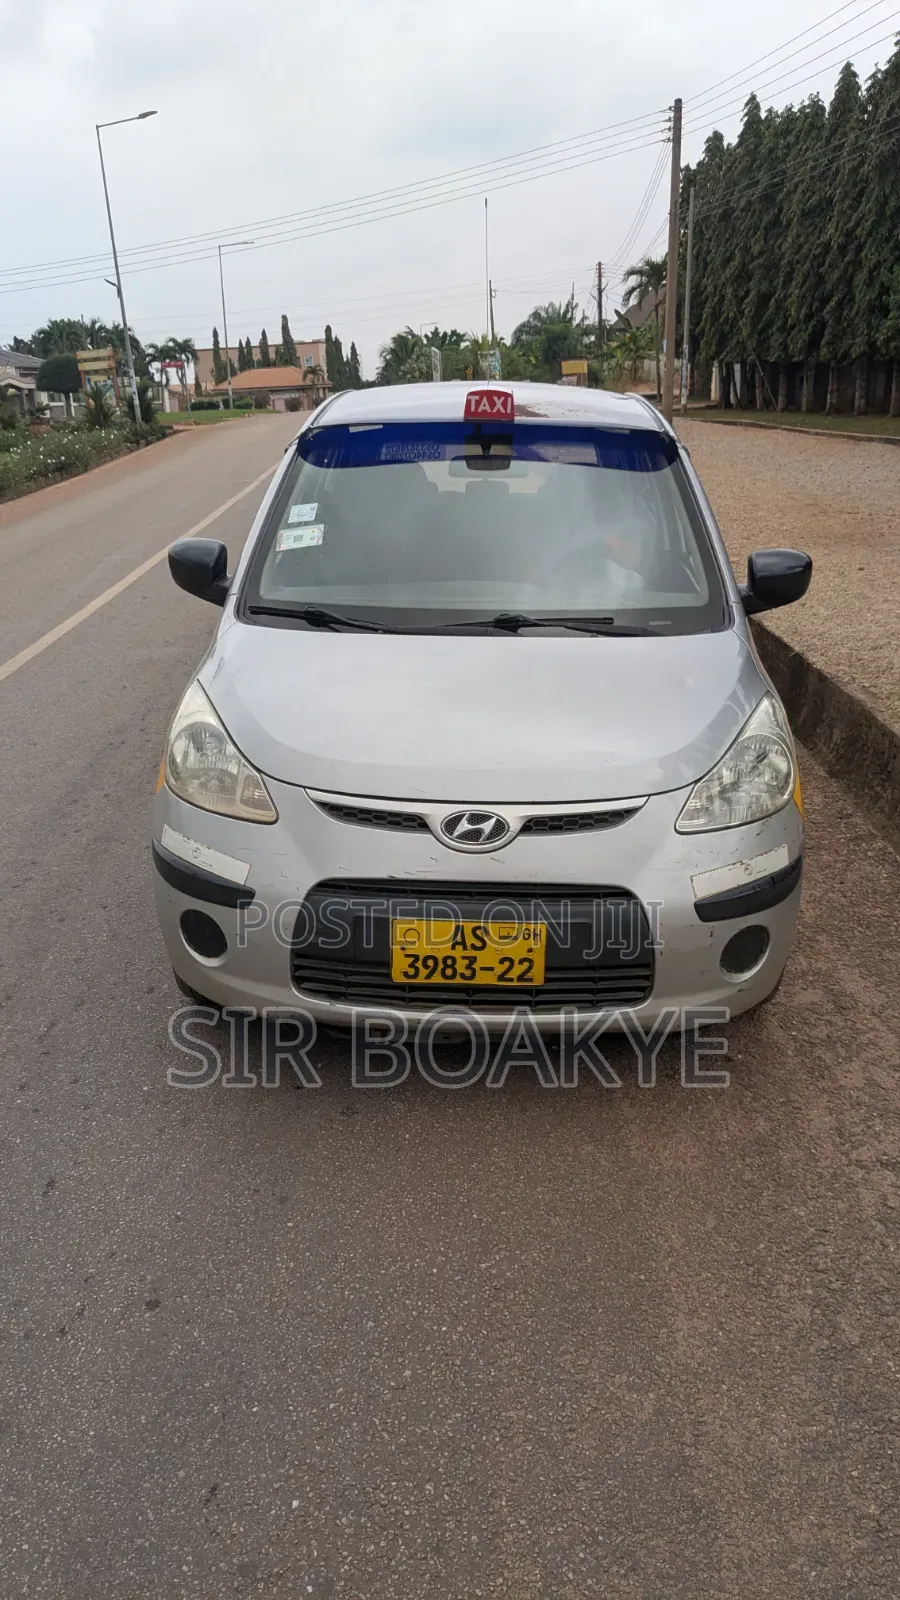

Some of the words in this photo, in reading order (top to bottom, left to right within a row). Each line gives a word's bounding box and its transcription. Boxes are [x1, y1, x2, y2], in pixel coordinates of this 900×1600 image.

[467, 395, 512, 414] TAXI
[451, 924, 489, 951] AS
[522, 928, 542, 942] GH
[402, 953, 534, 982] 3983-22
